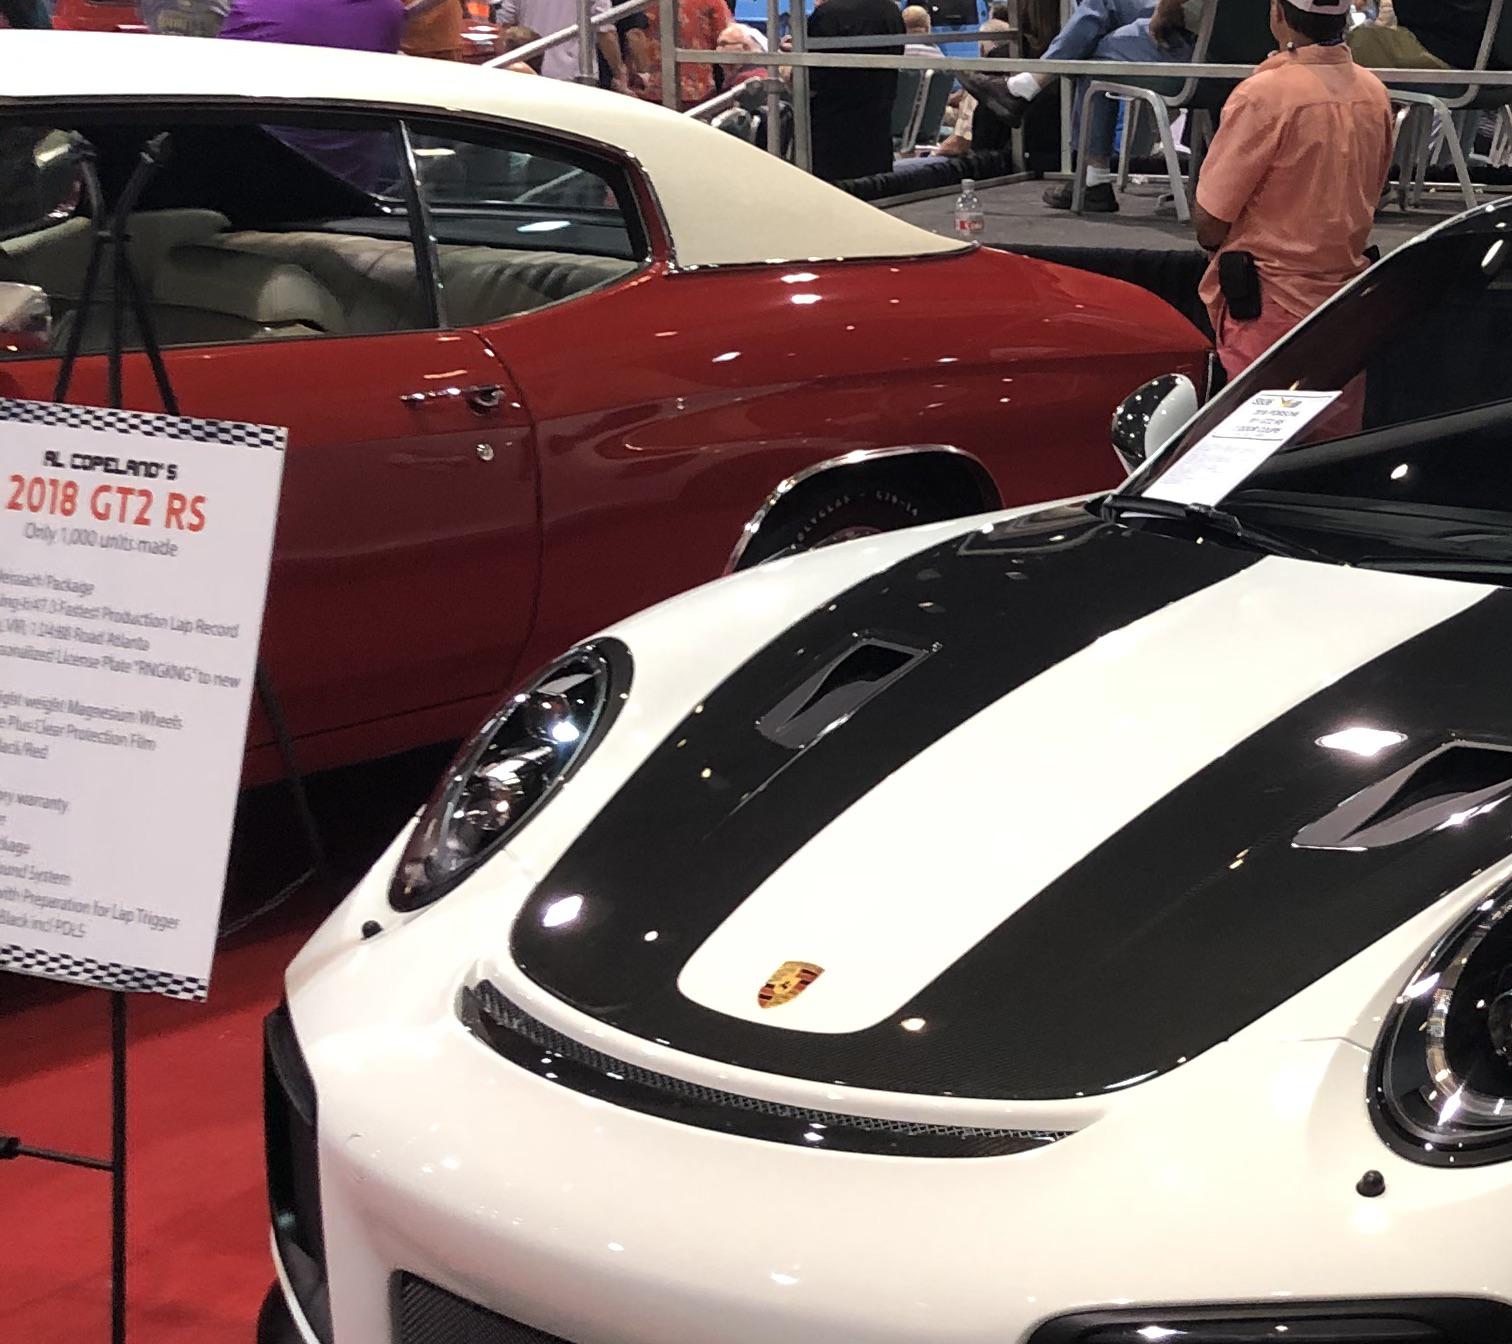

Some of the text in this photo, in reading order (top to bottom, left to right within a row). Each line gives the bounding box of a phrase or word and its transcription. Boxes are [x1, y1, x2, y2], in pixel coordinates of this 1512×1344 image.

[42, 450, 178, 480] AL COPELAND'S
[5, 474, 206, 532] 2018 GT2 RS
[24, 522, 178, 557] Only 1,000 units made
[101, 606, 167, 630] Production
[170, 616, 192, 635] Lap
[195, 617, 240, 638] Record
[213, 673, 240, 688] new
[94, 899, 110, 917] for
[112, 903, 135, 925] Lap
[137, 906, 181, 932] Trigger
